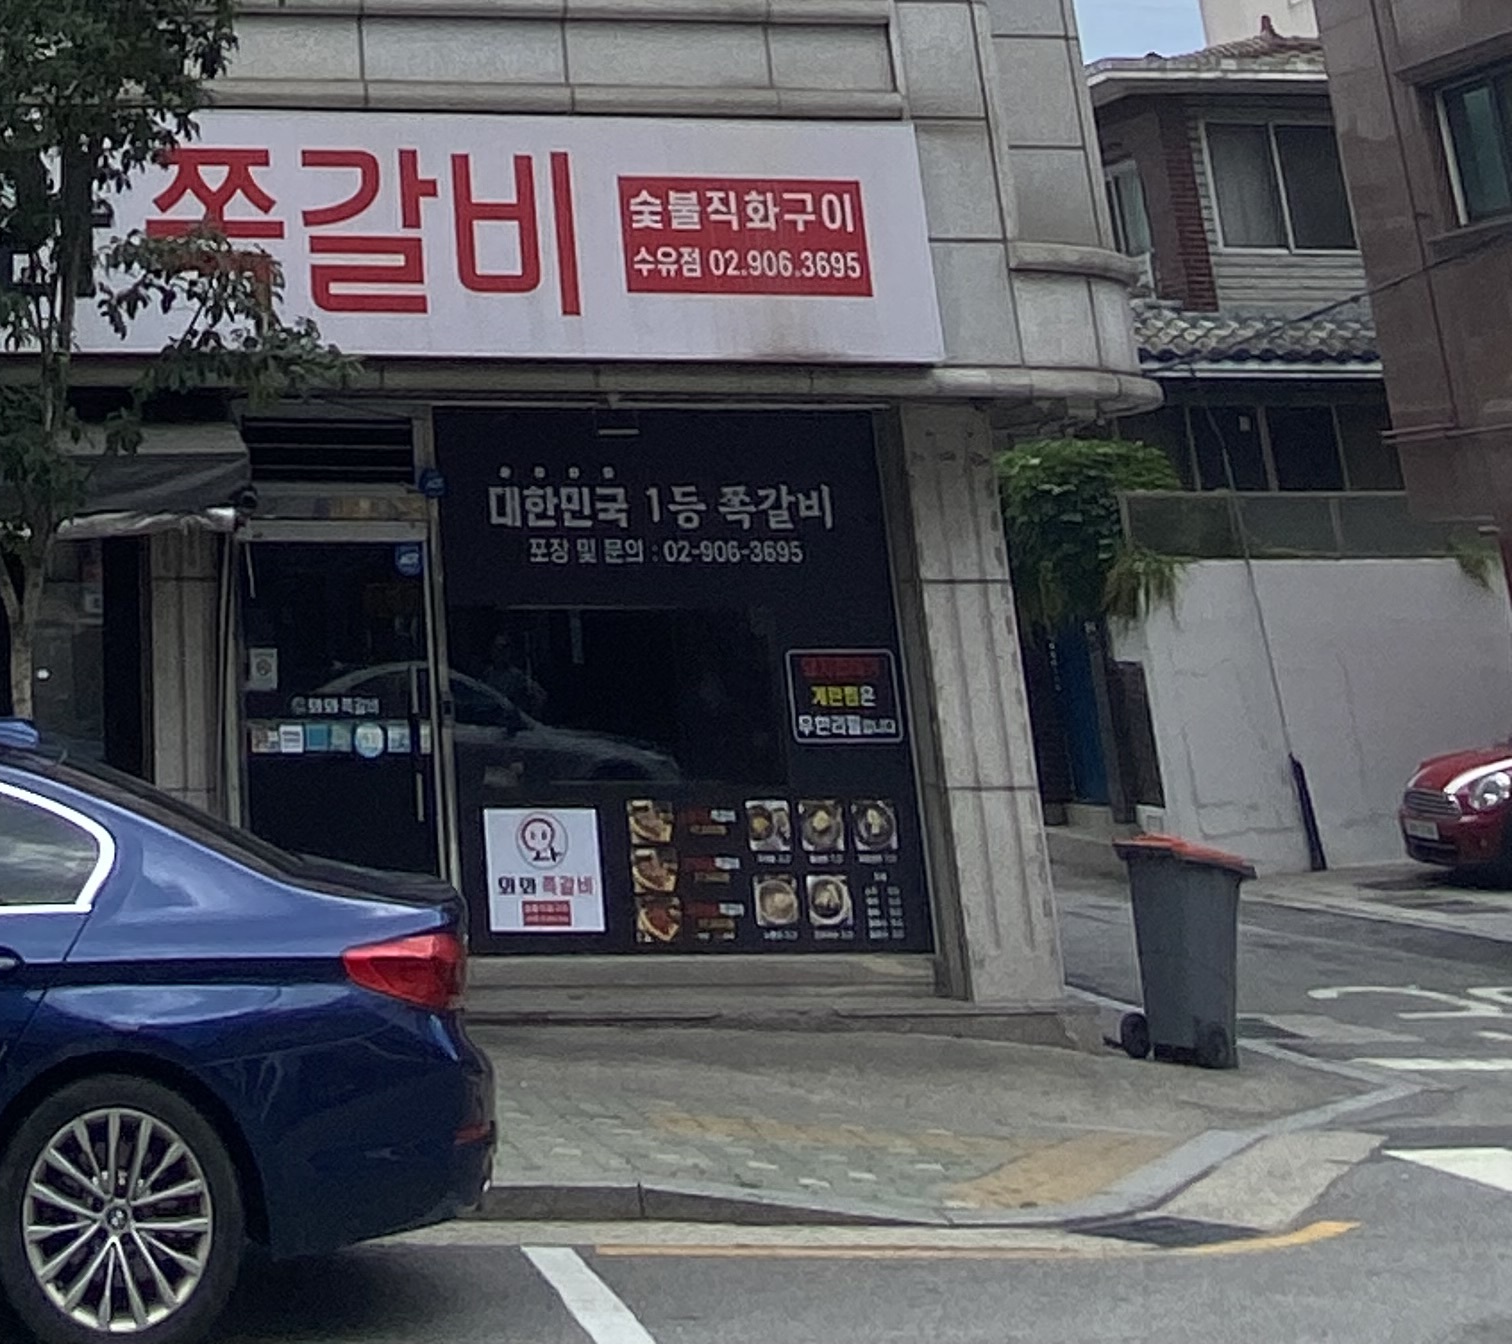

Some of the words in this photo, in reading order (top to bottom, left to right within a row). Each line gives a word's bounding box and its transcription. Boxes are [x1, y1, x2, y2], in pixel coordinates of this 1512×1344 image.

[145, 147, 582, 317] 쪽갈비
[628, 189, 855, 234] 숯불직화구이
[633, 248, 703, 280] 수유점
[708, 249, 862, 280] 02.906.3695
[488, 483, 630, 530] 대한민국
[645, 484, 707, 529] 1등
[718, 484, 834, 530] 쪽갈비
[529, 538, 570, 564] 포장
[577, 538, 598, 564] 및
[662, 539, 805, 564] 02-906-3695
